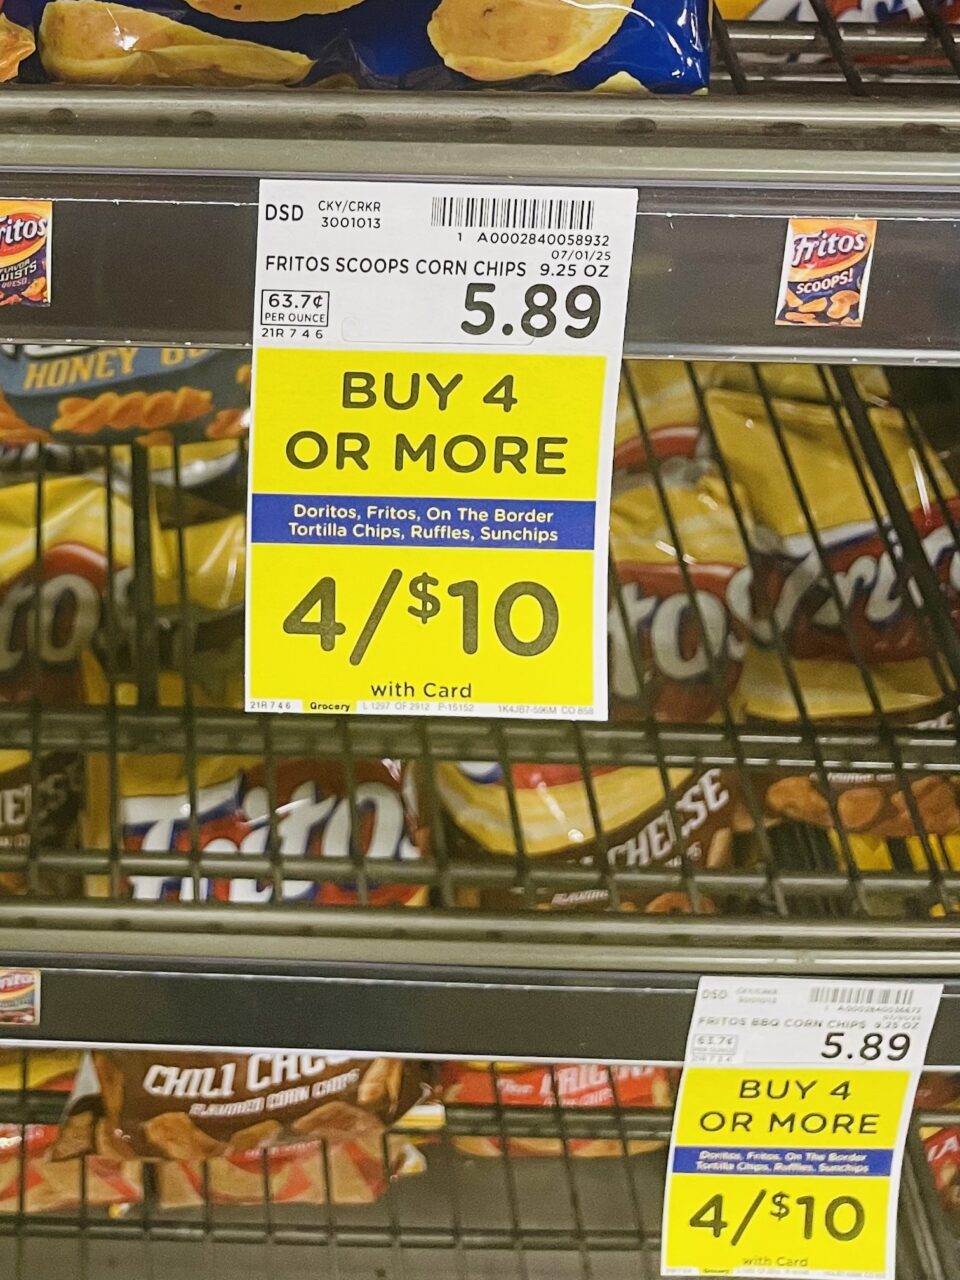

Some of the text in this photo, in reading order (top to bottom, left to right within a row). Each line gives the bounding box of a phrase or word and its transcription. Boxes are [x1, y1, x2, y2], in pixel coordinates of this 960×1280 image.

[265, 200, 382, 221] DSD CKY/CRKR
[321, 217, 382, 229] 3001013
[477, 232, 610, 248] A0002840058932
[791, 232, 866, 266] Fritos
[551, 250, 612, 261] 07/01/25
[265, 256, 610, 278] FRITOS SCOOPS CORN CHIPS 9.25 OZ
[796, 268, 854, 294] SCOOPS!
[268, 293, 324, 310] 63.7¢
[460, 282, 602, 339] 5.89
[265, 312, 326, 323] PER OUNCE
[261, 328, 284, 339] 21R
[290, 328, 297, 339] 7
[302, 328, 311, 339] 4
[23, 347, 138, 391] HONEY
[341, 371, 518, 413] BUY 4
[285, 430, 568, 475] OR MORE
[293, 503, 554, 523] Doritos, Fritos, On The Border
[288, 521, 559, 543] Tortilla Chips, Ruffles, Sunchips
[282, 568, 560, 666] 4/$10
[370, 682, 472, 699] with Card
[310, 701, 351, 712] Grocery
[821, 1032, 911, 1061] 5.89
[143, 1063, 237, 1098] CHILI
[739, 1080, 851, 1100] BUY 4
[699, 1111, 880, 1134] OR MORE
[689, 1189, 865, 1246] 4/$10
[743, 1257, 808, 1267] with Card
